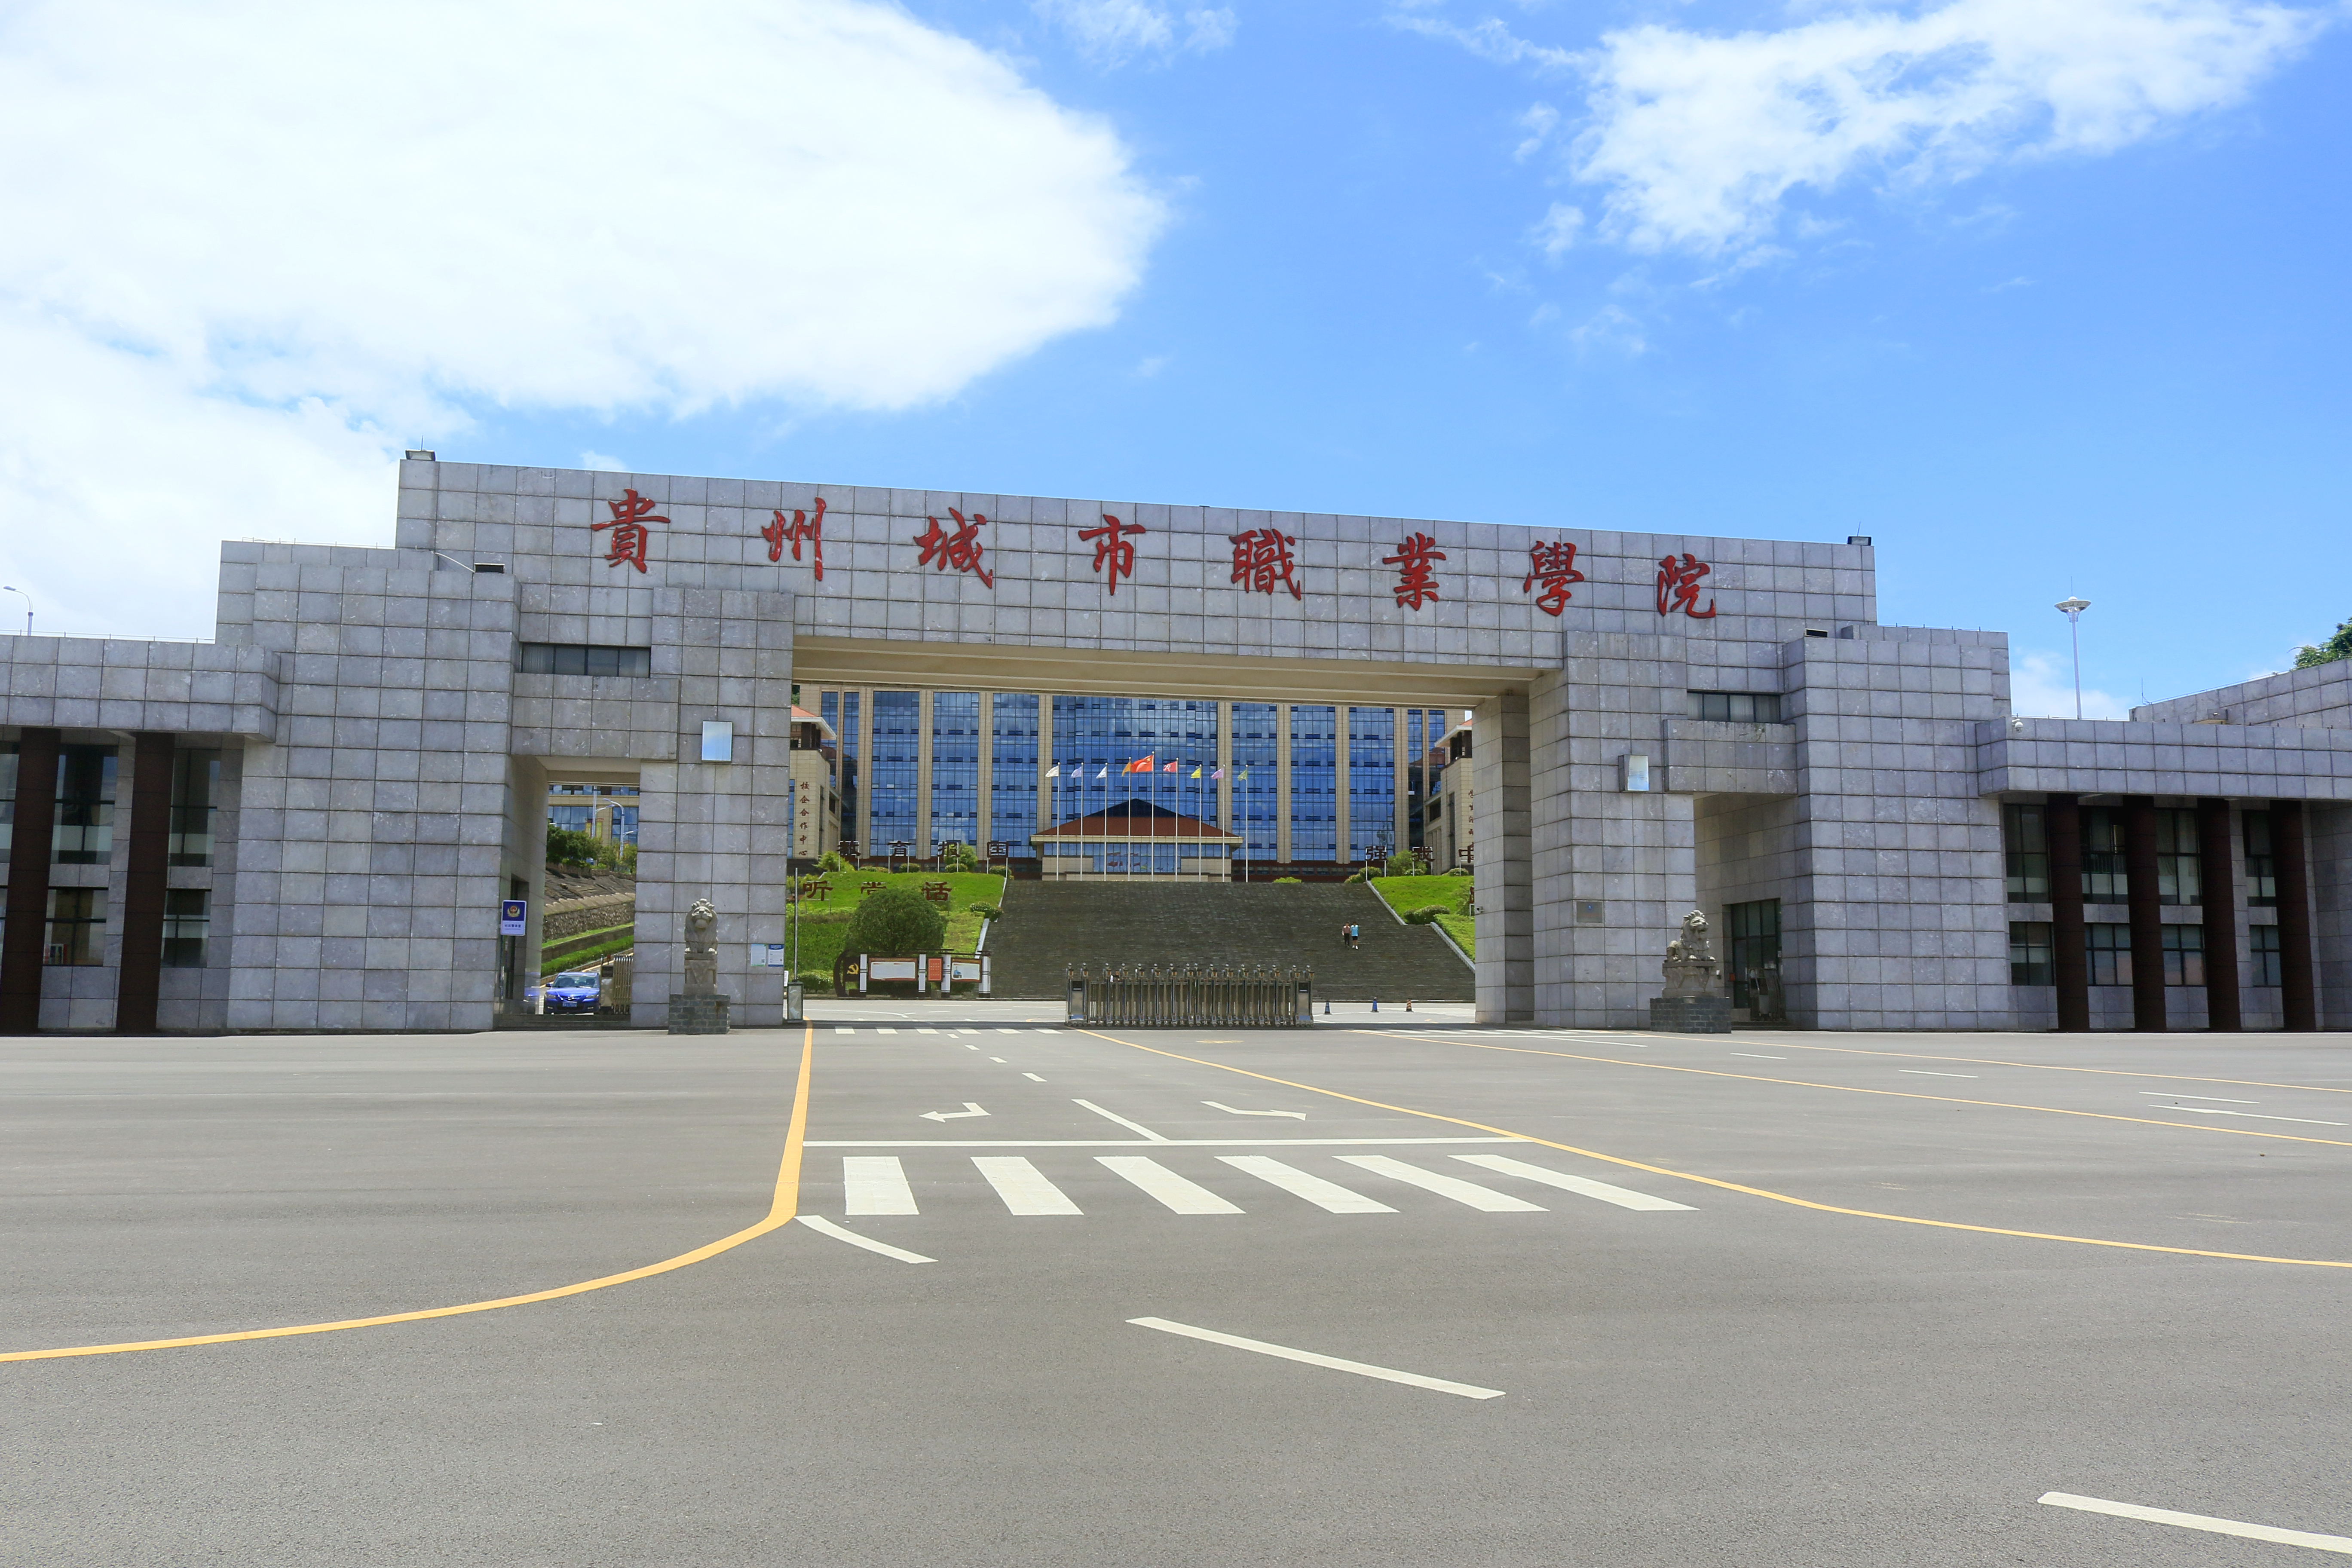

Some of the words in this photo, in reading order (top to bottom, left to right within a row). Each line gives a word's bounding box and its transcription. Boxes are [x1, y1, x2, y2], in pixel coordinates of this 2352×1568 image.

[591, 488, 1717, 618] 貴州城市職業學院
[798, 781, 810, 856] 校企合作中心
[836, 840, 1009, 858] 教育报国
